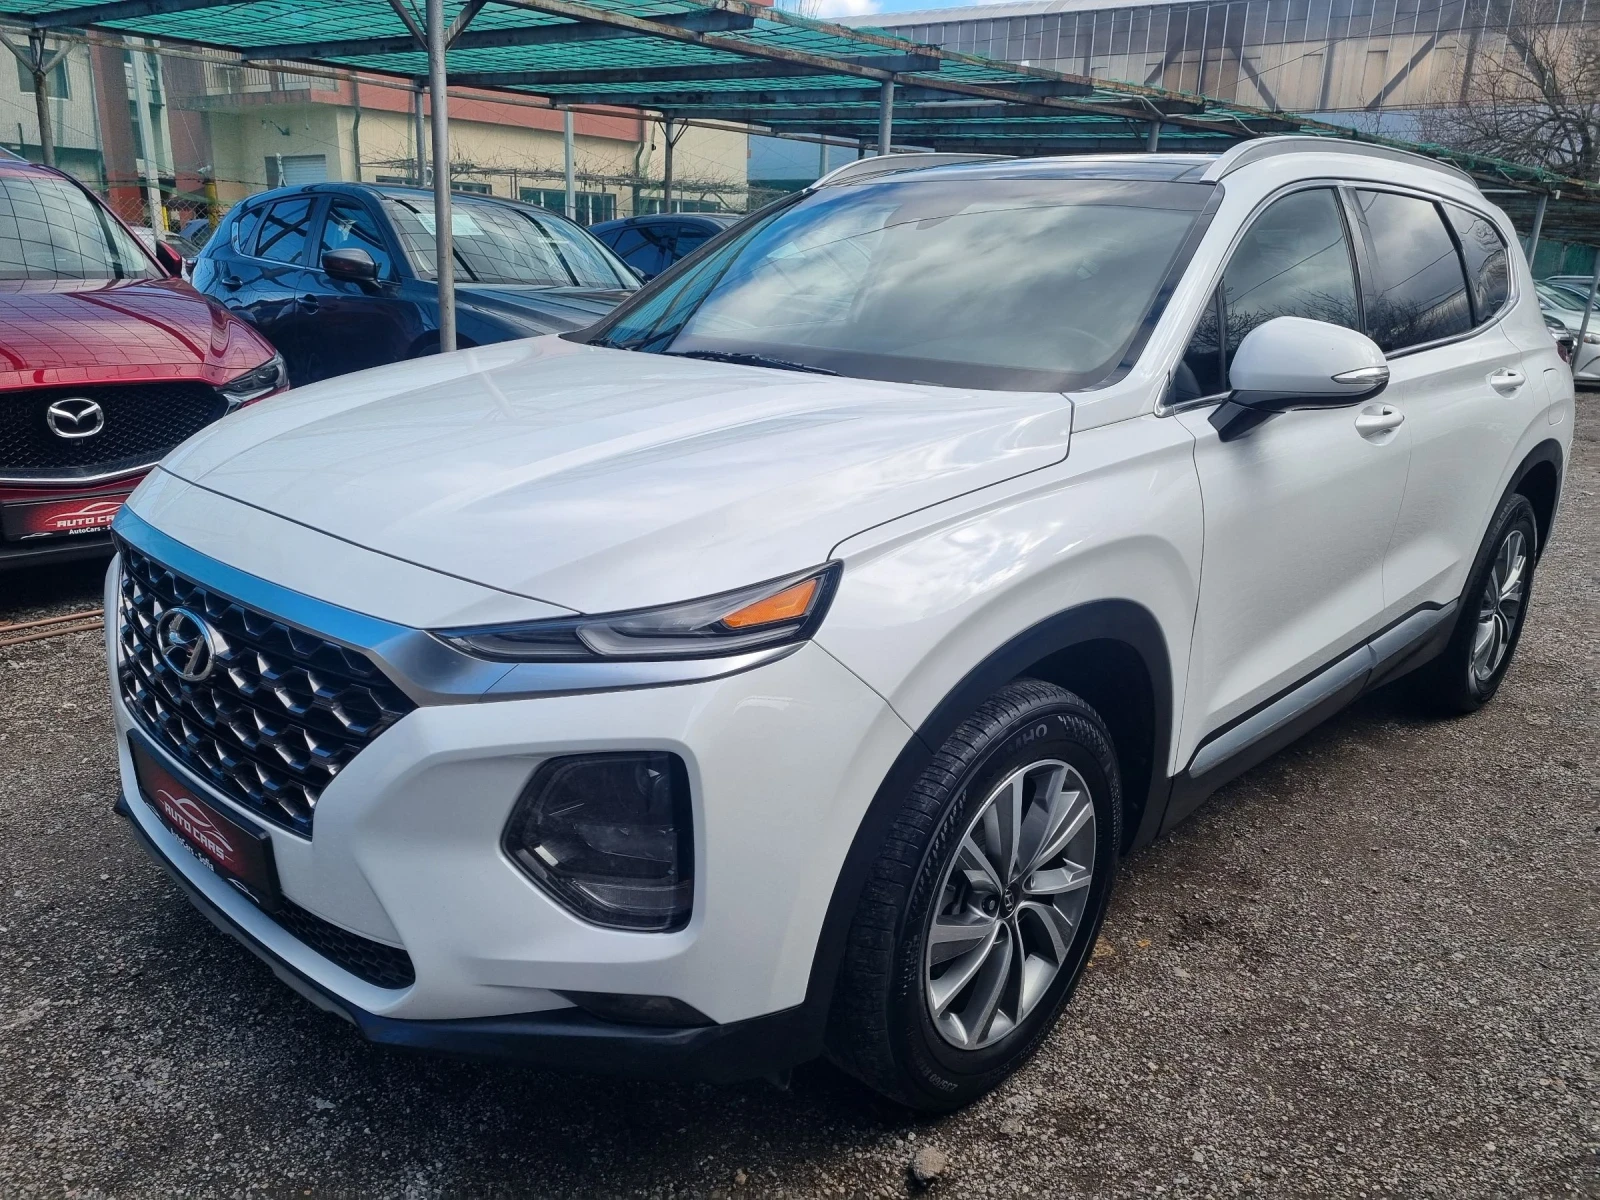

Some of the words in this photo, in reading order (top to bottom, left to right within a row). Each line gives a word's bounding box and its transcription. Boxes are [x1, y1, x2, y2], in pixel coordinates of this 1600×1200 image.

[56, 517, 95, 527] AUTO
[97, 514, 116, 523] CA
[68, 526, 101, 535] AutoCars
[164, 800, 192, 834] AUTO
[192, 826, 225, 861] CARS
